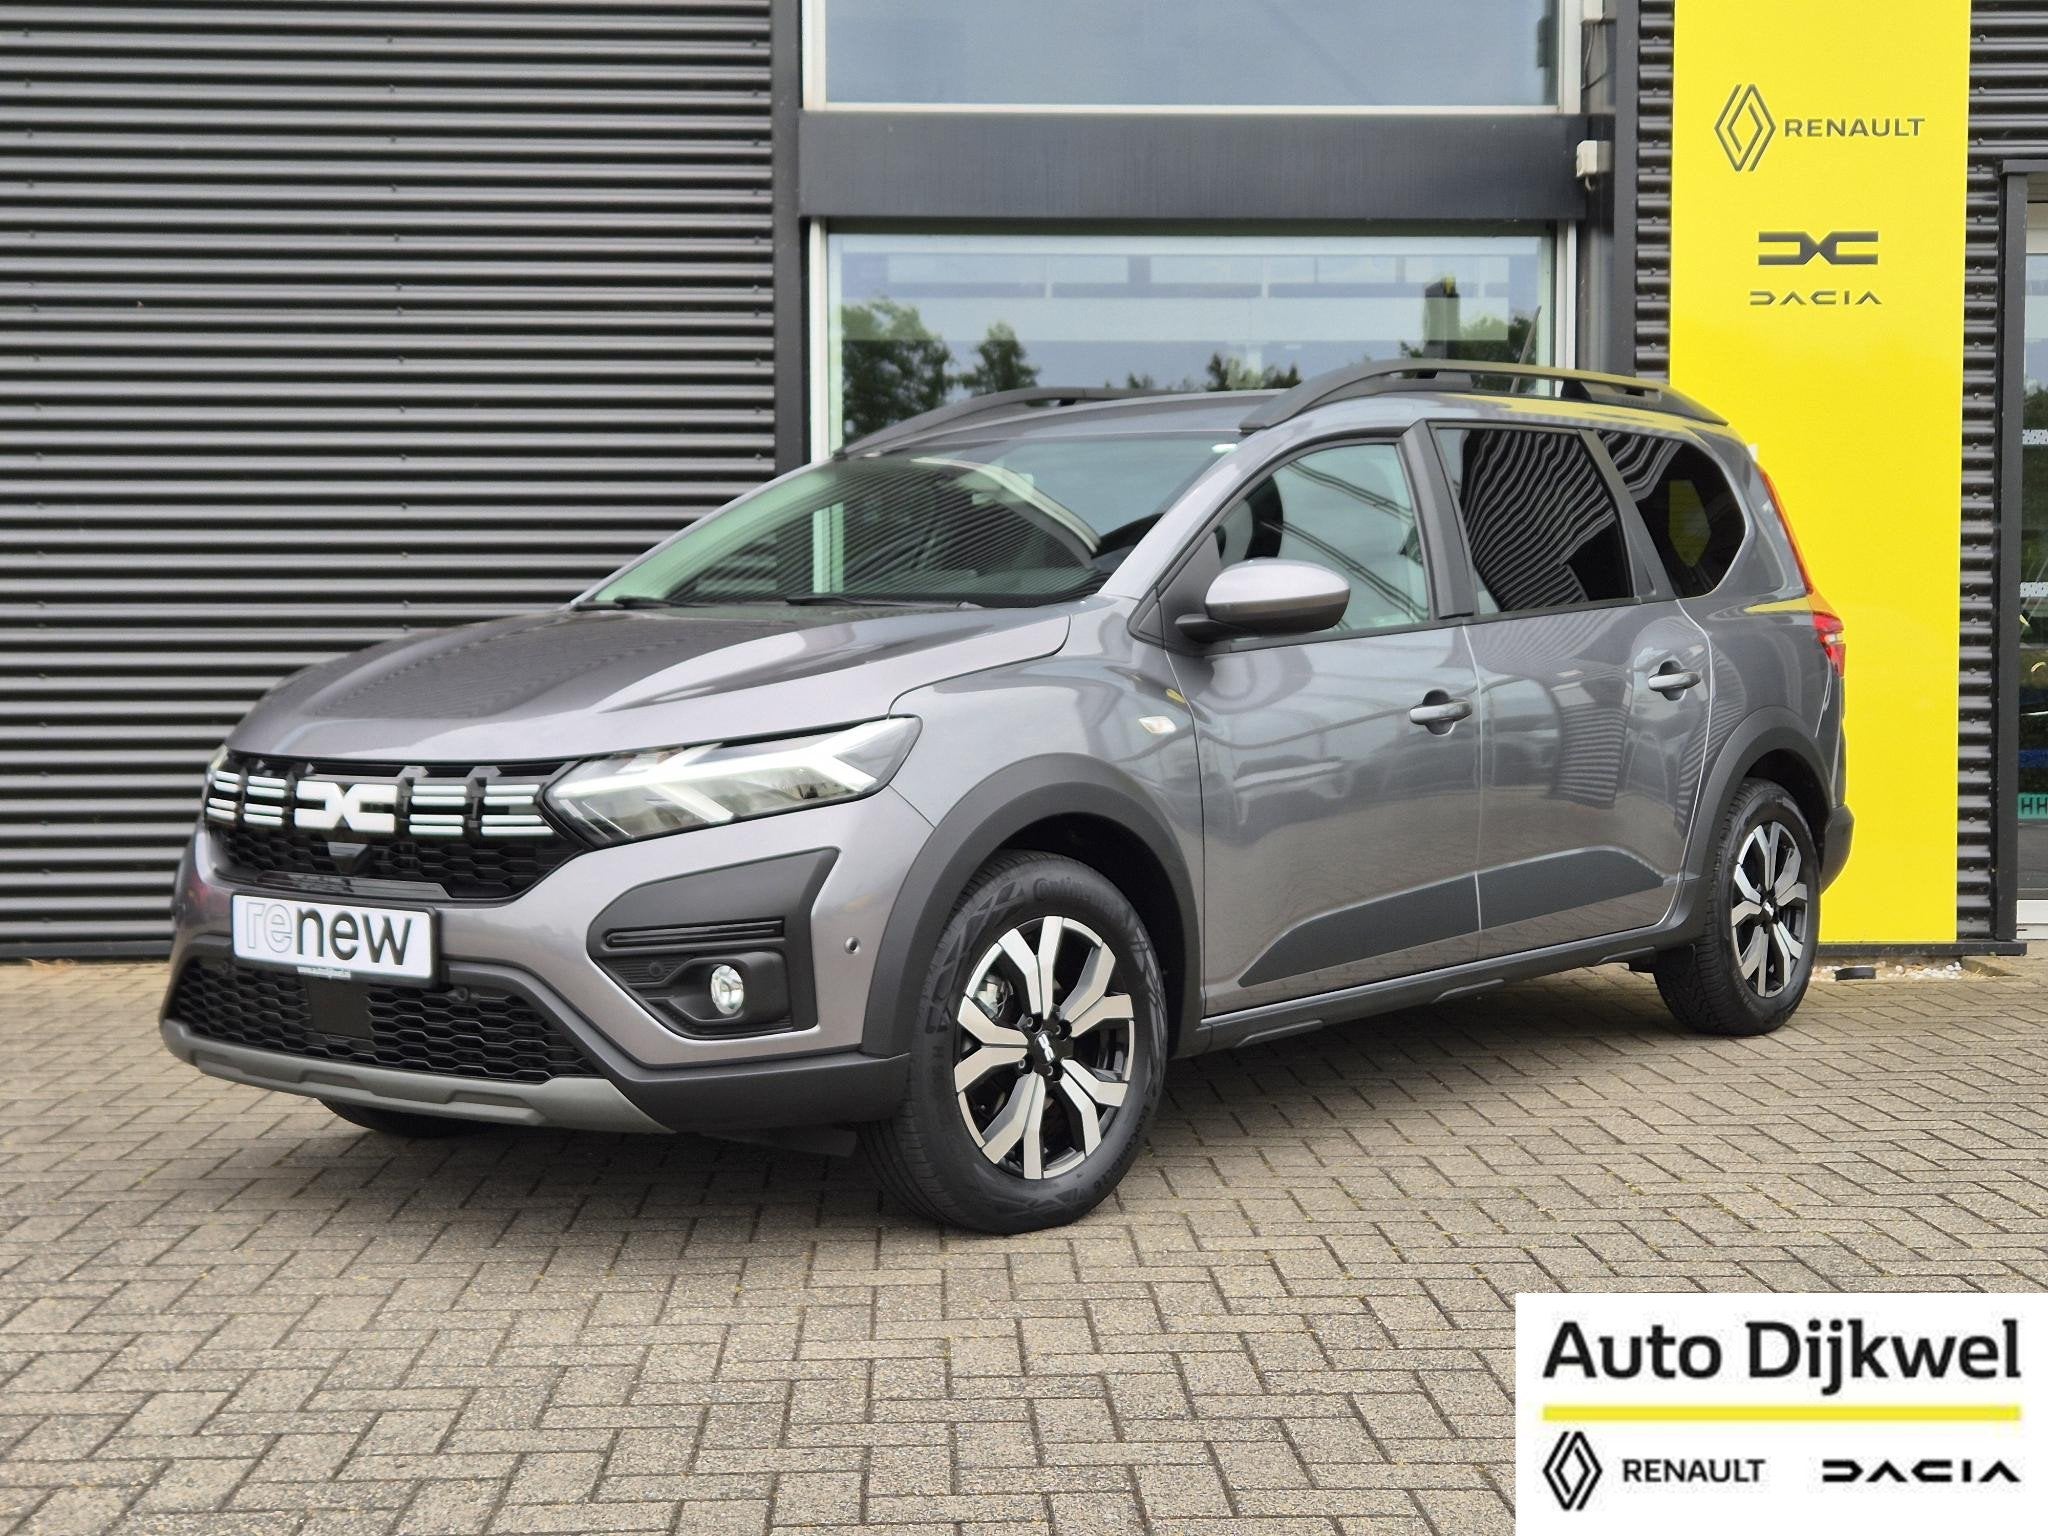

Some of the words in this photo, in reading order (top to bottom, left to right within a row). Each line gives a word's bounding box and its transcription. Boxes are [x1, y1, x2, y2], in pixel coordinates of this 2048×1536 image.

[1784, 117, 1926, 137] RENAULT
[1749, 290, 1882, 306] DACIA
[246, 902, 412, 966] renew
